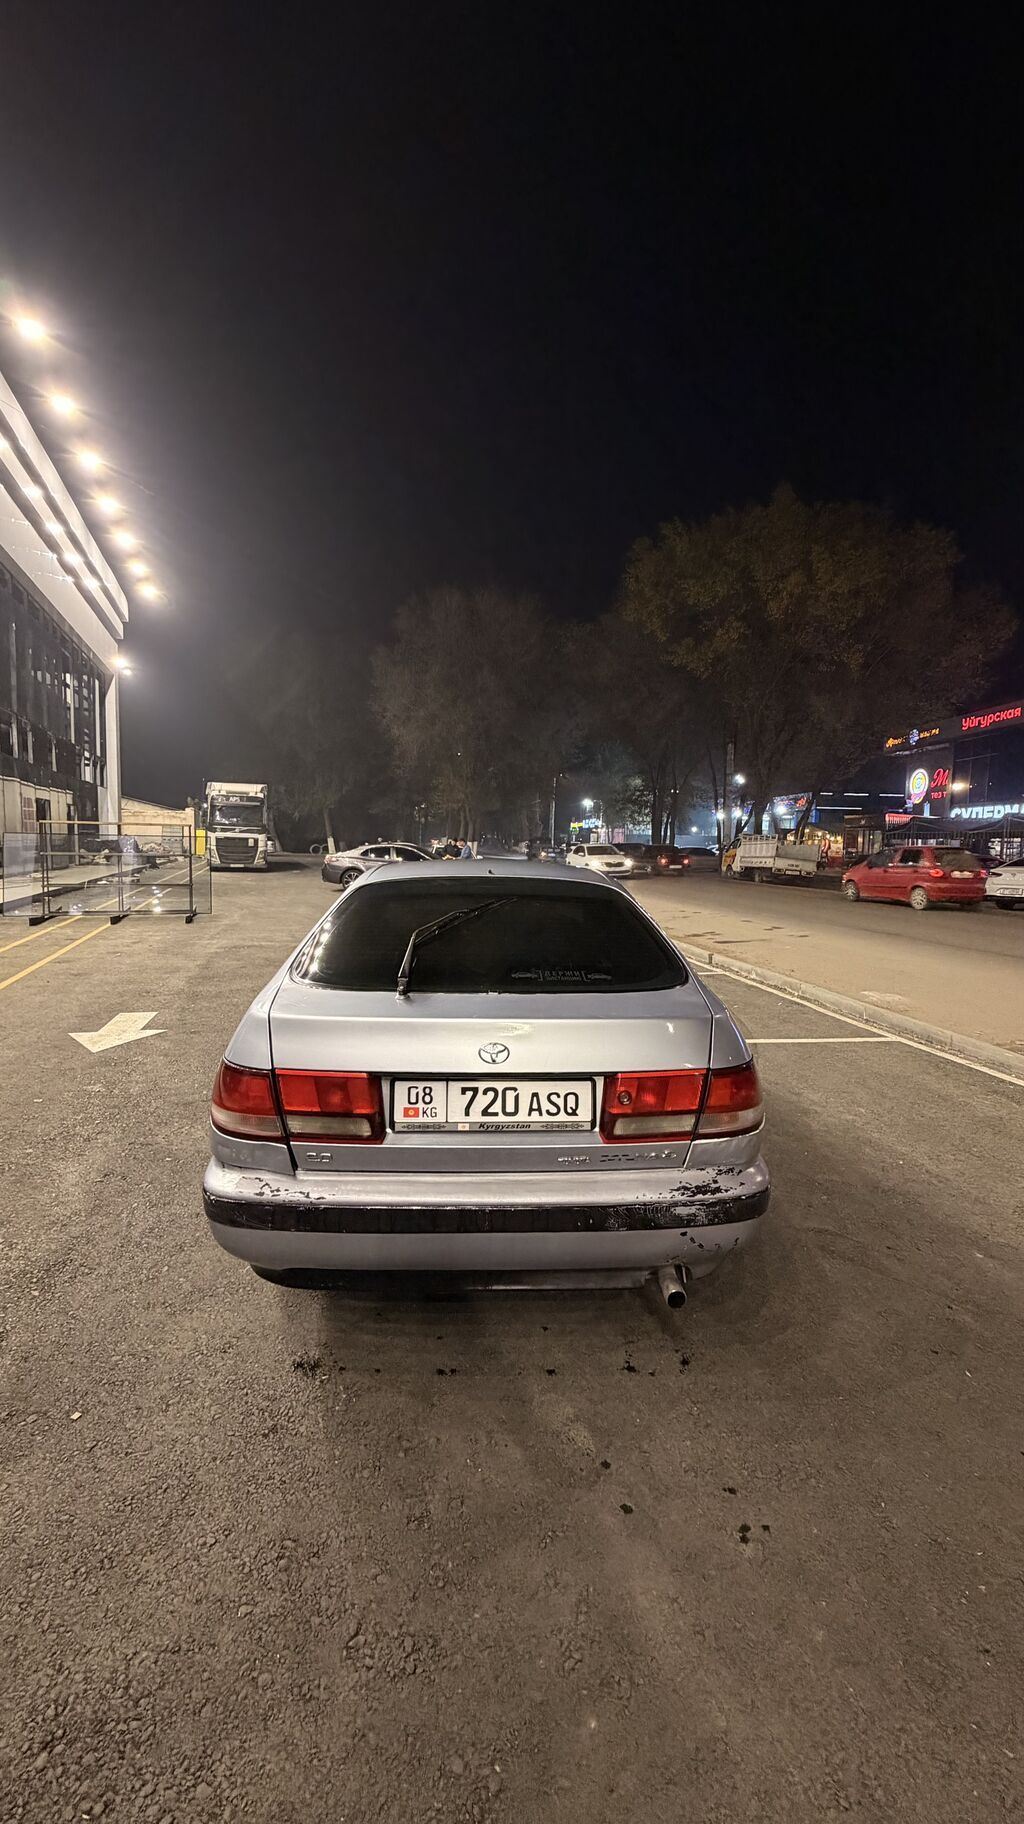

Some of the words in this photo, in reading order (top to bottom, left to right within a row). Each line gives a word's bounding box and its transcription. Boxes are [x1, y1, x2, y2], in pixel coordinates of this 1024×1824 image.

[962, 707, 1022, 730] Уйгурская
[950, 803, 1024, 819] СУПЕРМ
[407, 1086, 434, 1105] 08
[461, 1087, 520, 1117] 720
[527, 1092, 579, 1117] ASQ
[422, 1107, 437, 1118] KG
[478, 1122, 531, 1131] Kyrgyzstan
